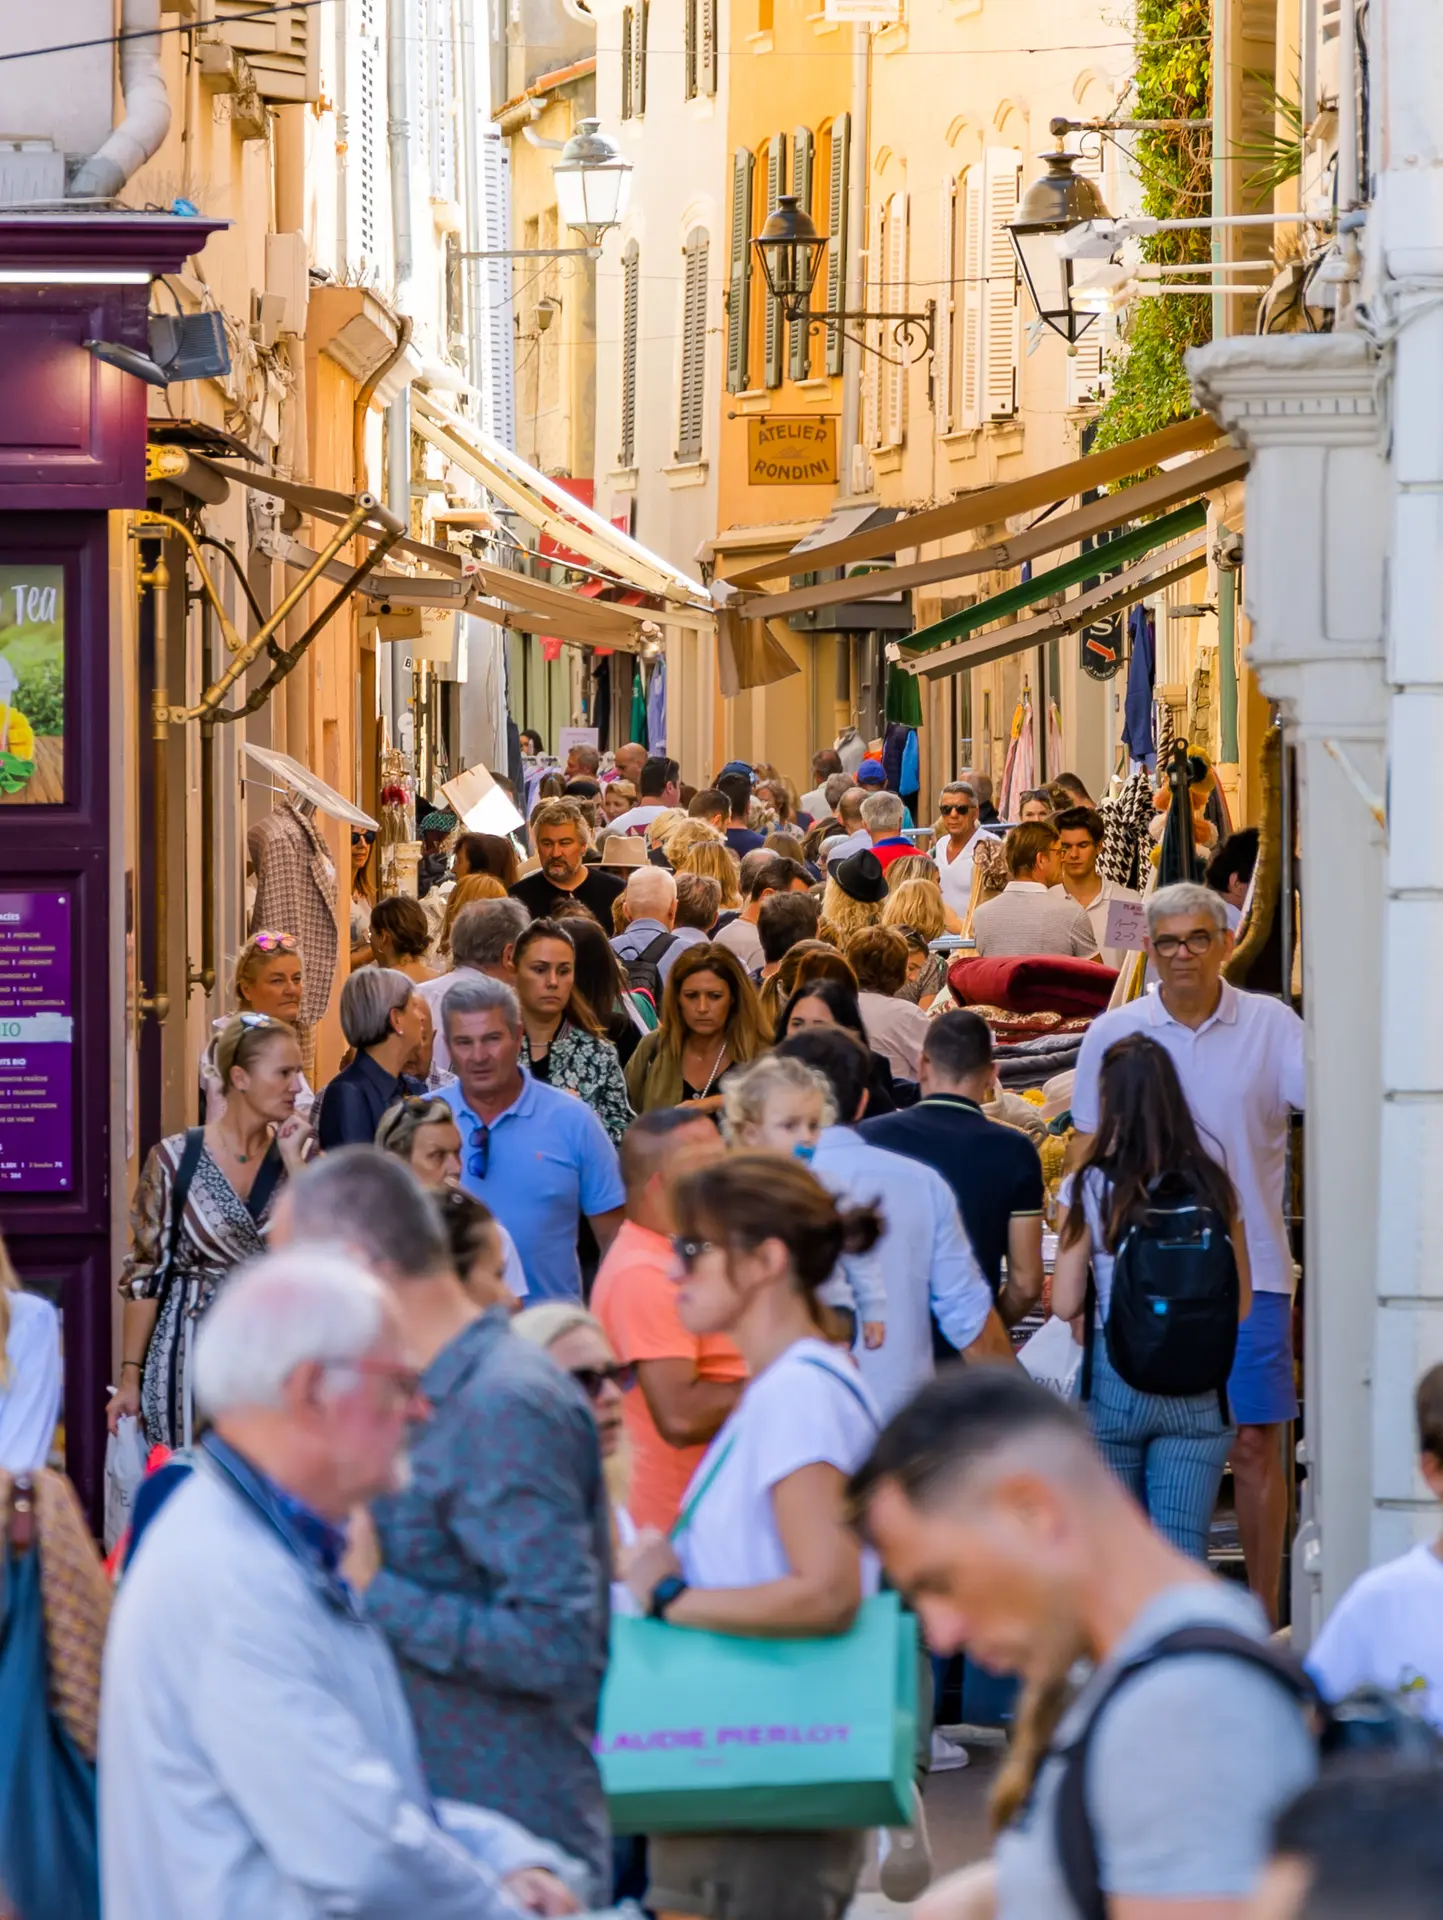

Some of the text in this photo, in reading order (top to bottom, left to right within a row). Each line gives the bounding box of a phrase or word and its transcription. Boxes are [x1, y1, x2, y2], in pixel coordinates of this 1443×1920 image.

[758, 424, 827, 446] ATELIER
[754, 458, 829, 480] RONDINI
[10, 584, 57, 627] Tea
